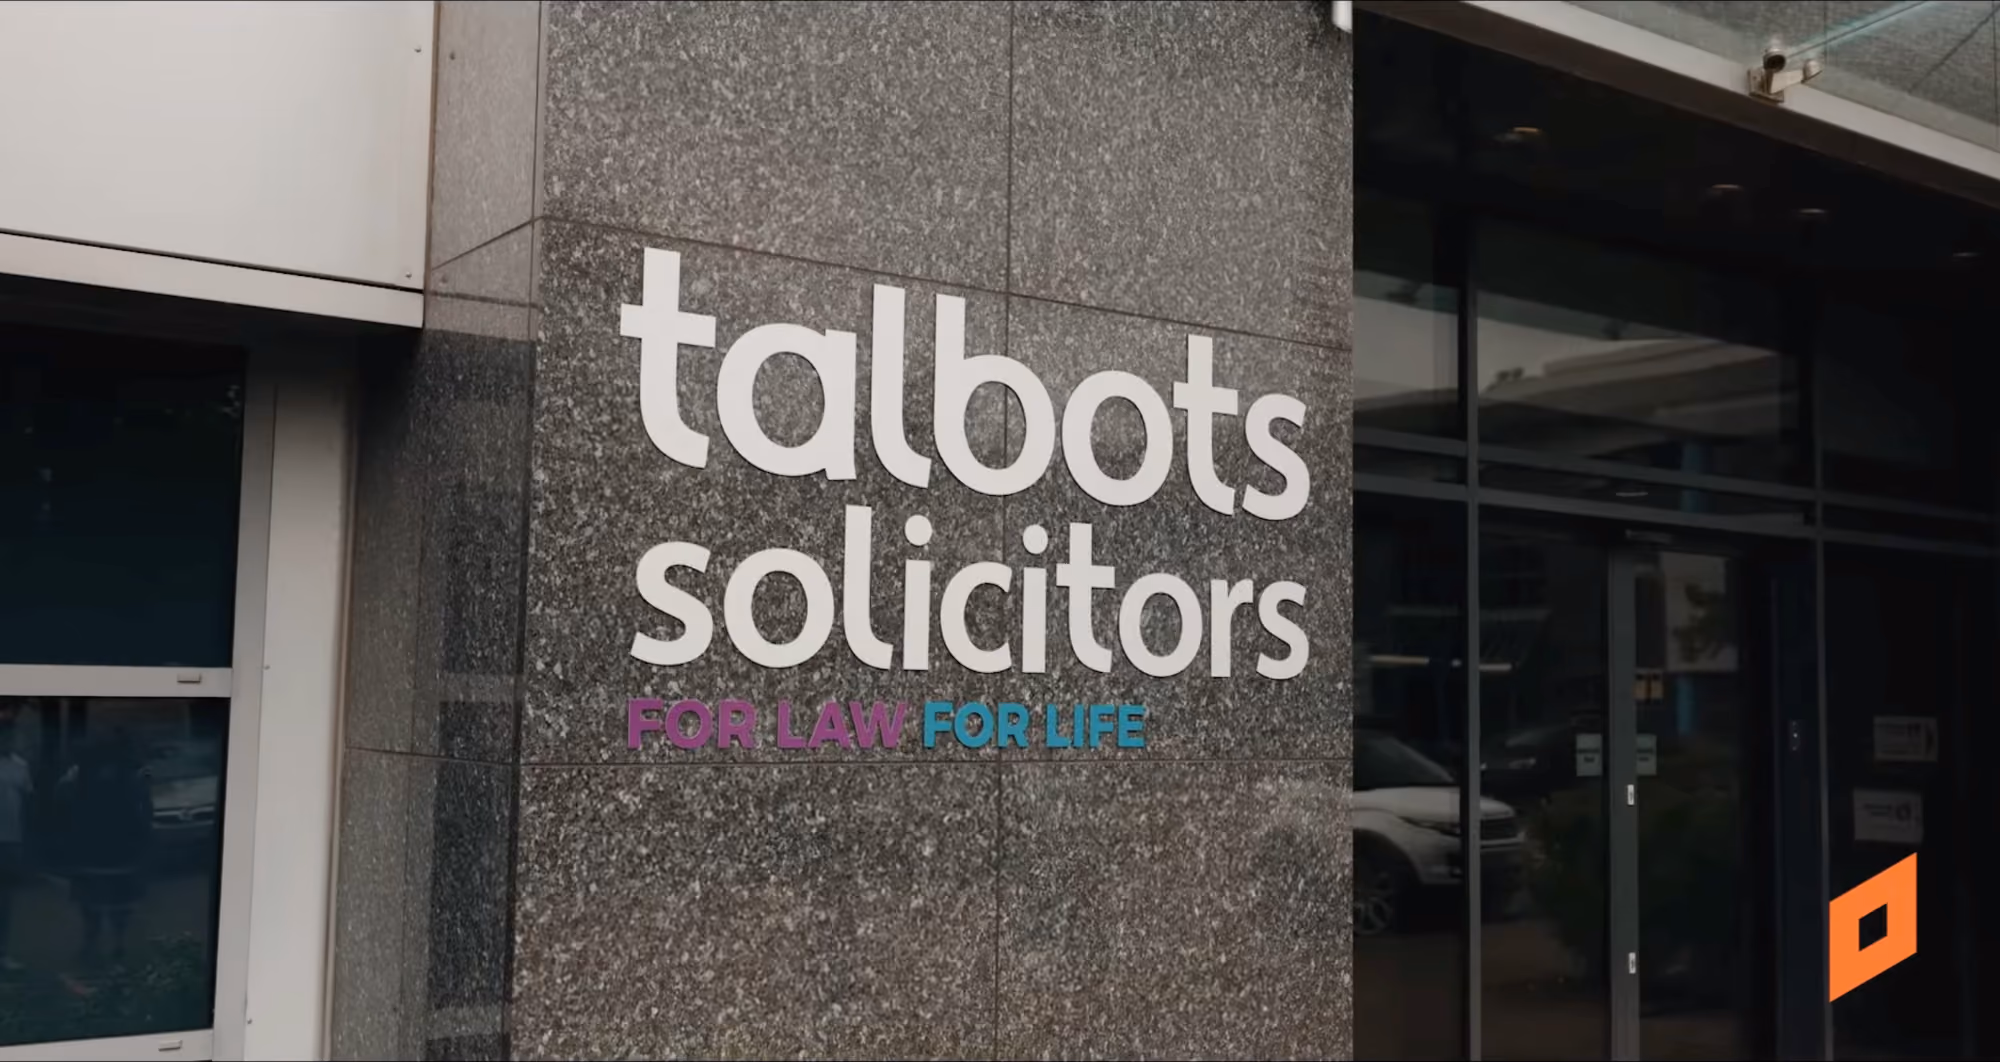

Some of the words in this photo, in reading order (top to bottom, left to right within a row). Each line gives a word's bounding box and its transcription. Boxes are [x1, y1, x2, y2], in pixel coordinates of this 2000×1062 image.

[620, 246, 1311, 520] talbots
[630, 504, 1310, 679] solicitors
[627, 699, 755, 748] FOR
[777, 701, 909, 748] LAW
[923, 701, 1030, 748] FOR
[1046, 703, 1147, 748] LIFE
